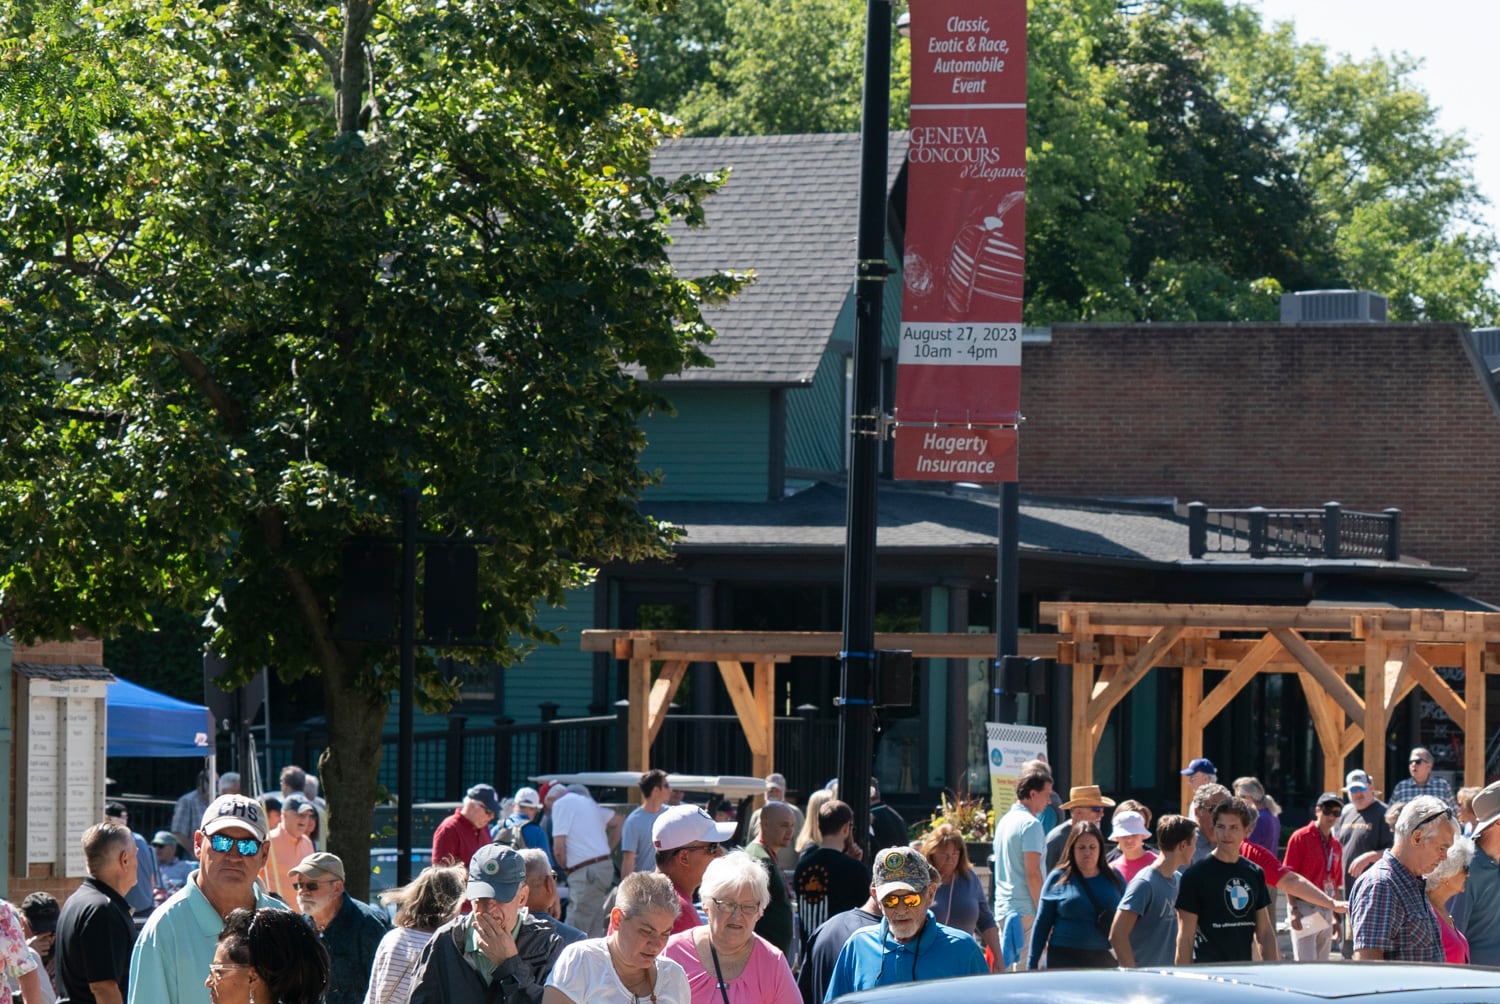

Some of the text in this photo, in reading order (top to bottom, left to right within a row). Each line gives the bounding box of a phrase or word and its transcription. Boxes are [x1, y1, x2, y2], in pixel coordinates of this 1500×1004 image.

[946, 16, 990, 34] Classic,
[928, 36, 1009, 54] Exotic & Race,
[933, 56, 1005, 73] Automobile
[952, 77, 987, 94] Event
[910, 126, 988, 150] GENEVA
[908, 147, 1001, 165] CONCOURS
[904, 327, 1017, 343] August 27, 2023
[914, 344, 952, 358] 10am
[967, 345, 998, 360] 4pm
[923, 432, 988, 455] Hagerty
[917, 455, 995, 473] Insurance
[218, 802, 258, 822] CHS
